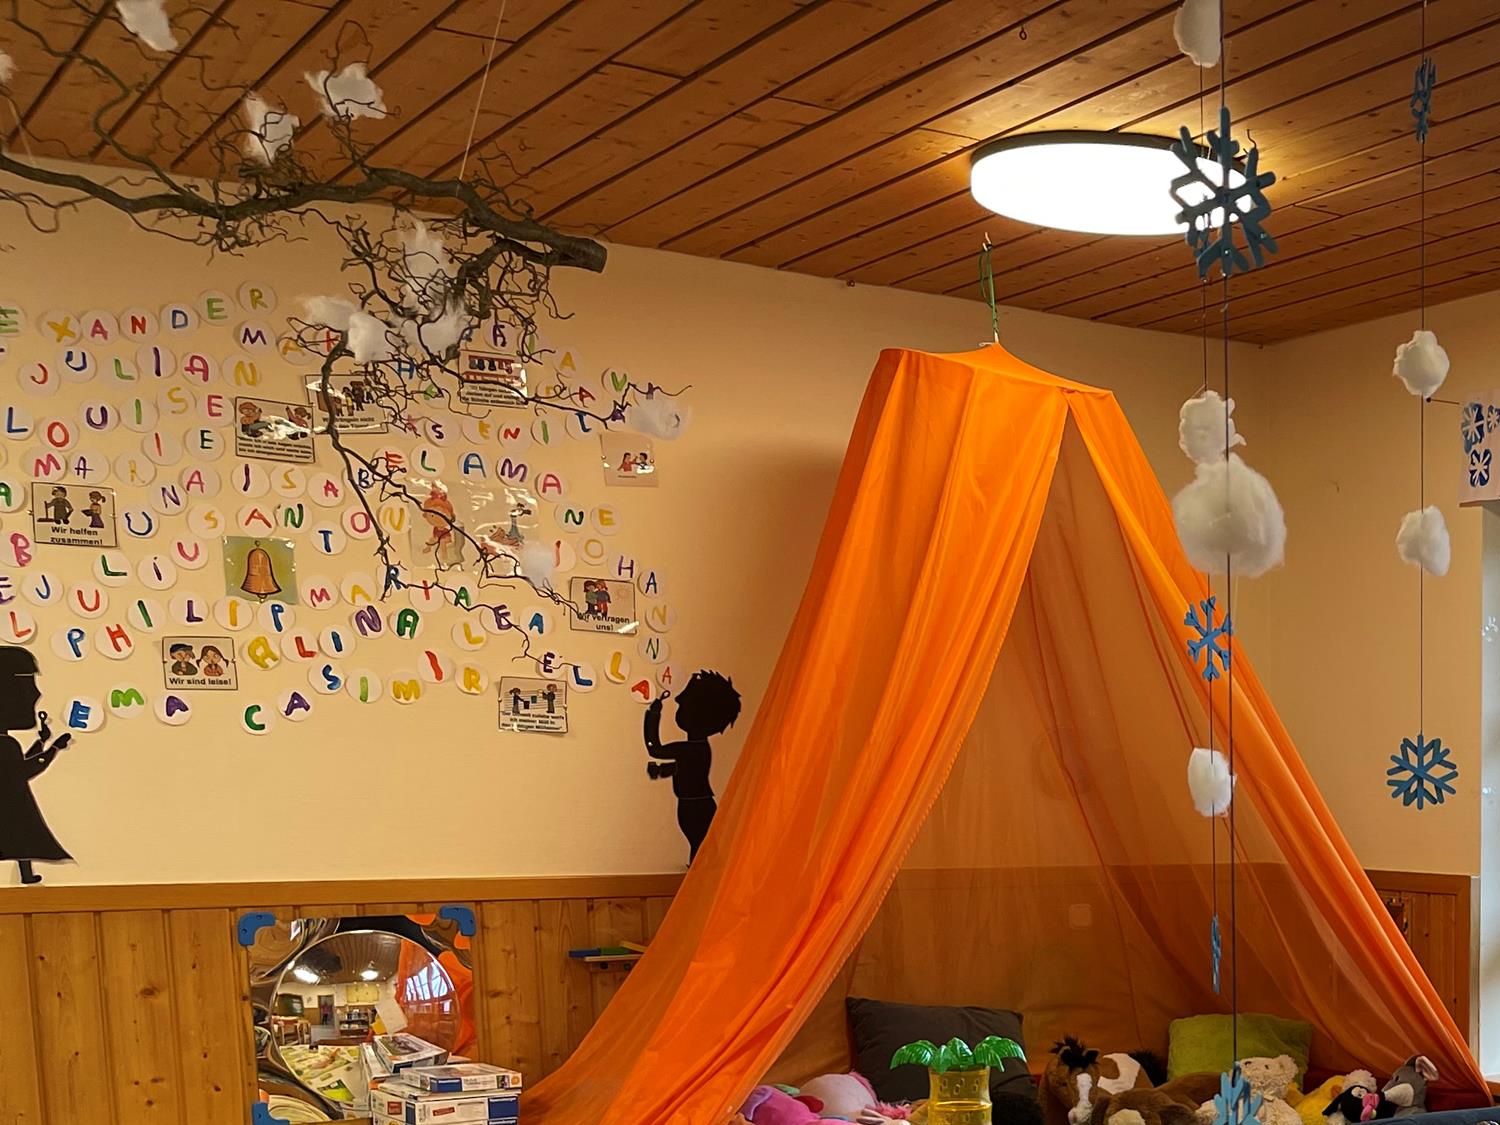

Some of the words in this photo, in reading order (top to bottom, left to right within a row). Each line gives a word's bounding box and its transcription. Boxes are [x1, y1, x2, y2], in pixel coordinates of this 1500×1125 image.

[30, 346, 258, 388] JULIAN
[7, 387, 223, 447] LOUISE
[67, 600, 285, 658] PHILIP
